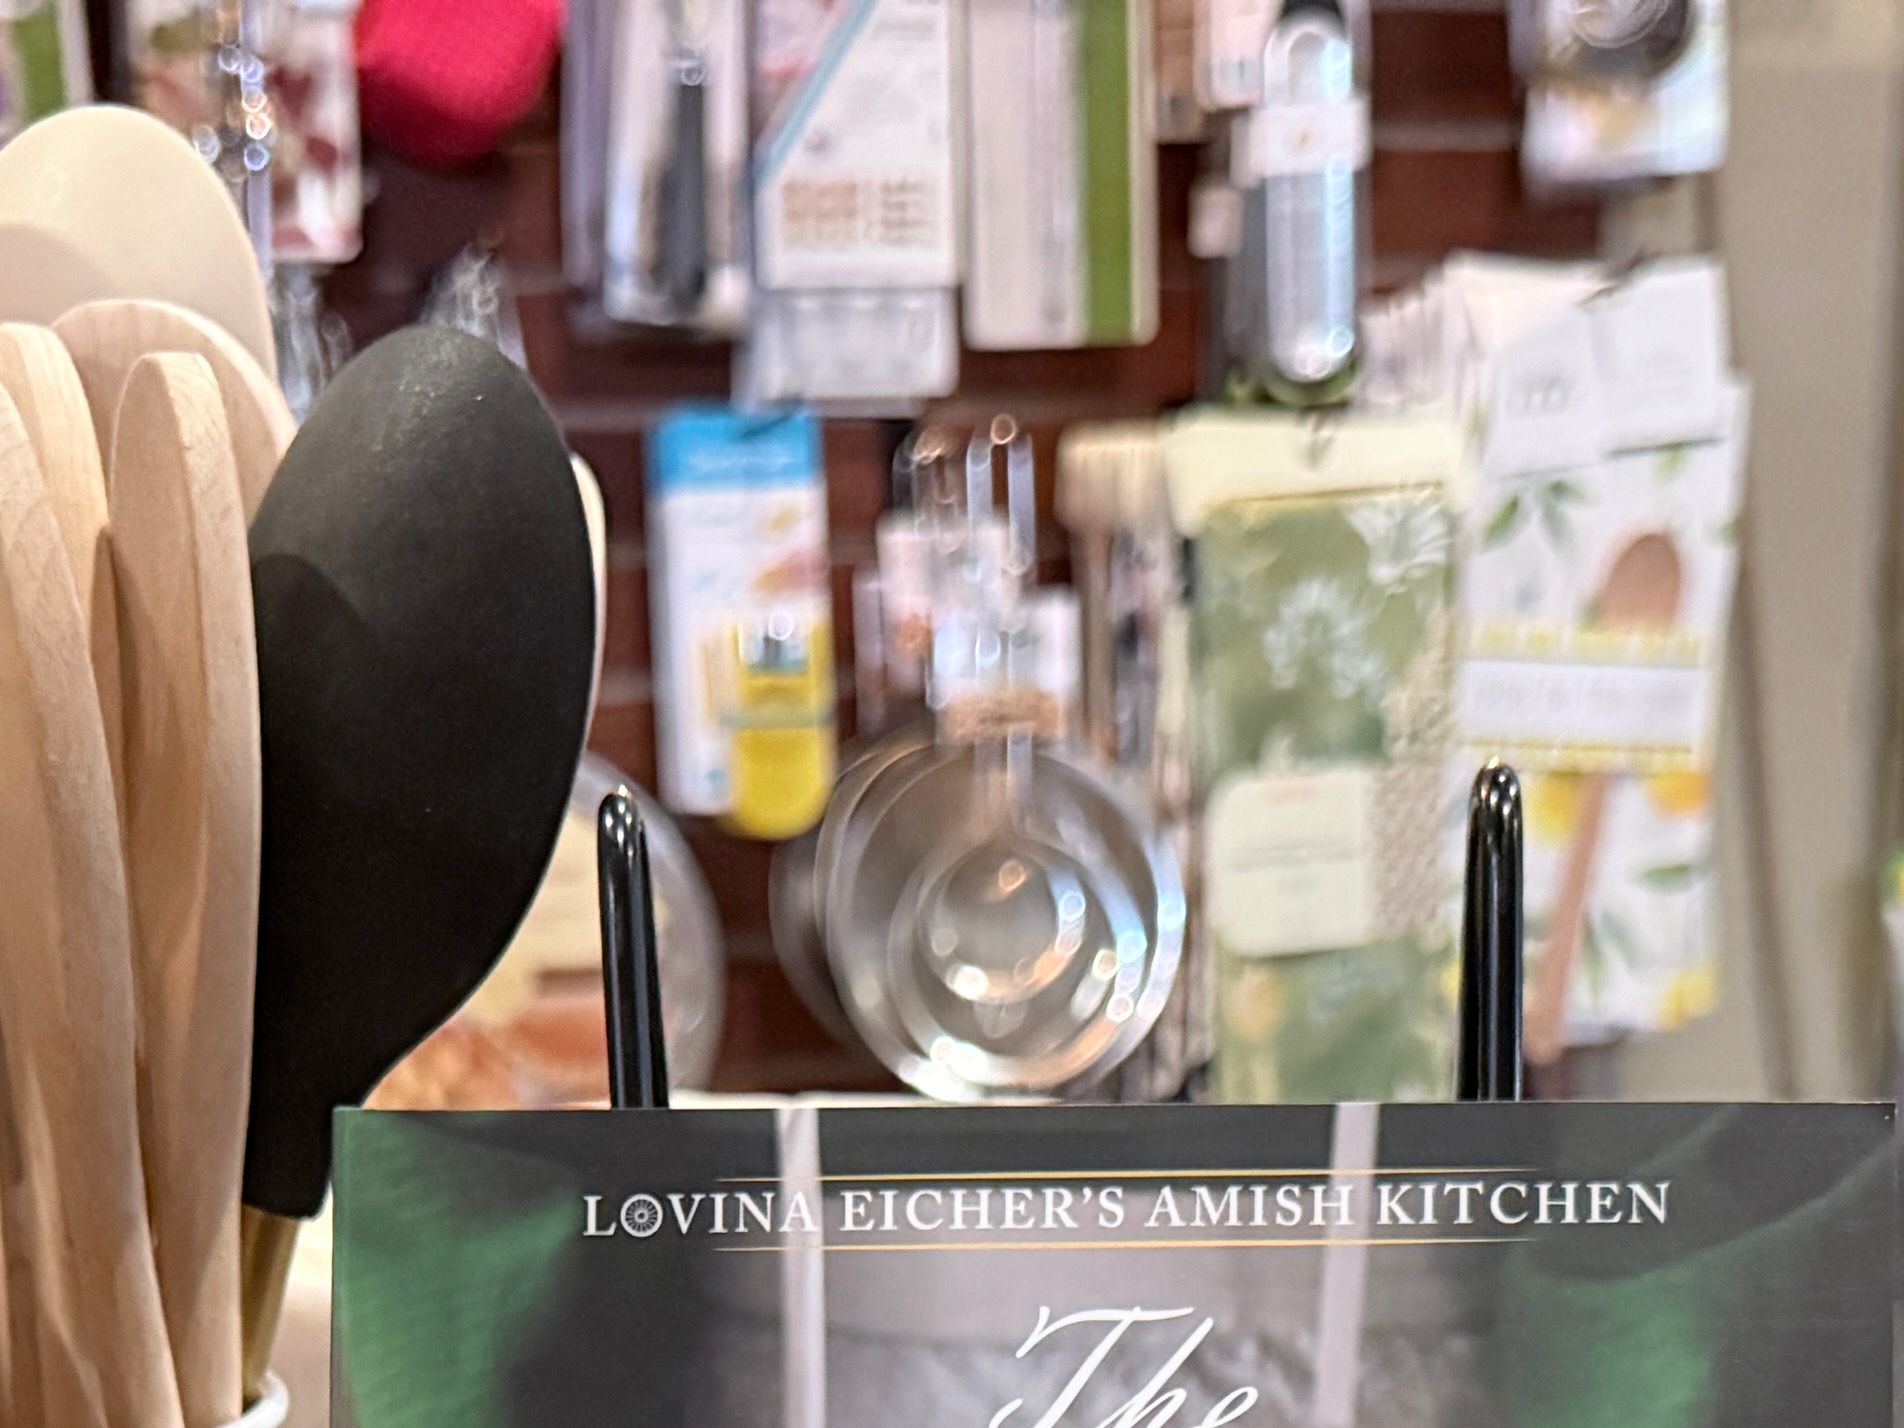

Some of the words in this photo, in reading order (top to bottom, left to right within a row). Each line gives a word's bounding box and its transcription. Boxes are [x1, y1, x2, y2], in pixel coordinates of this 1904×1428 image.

[582, 1192, 817, 1238] LOVINA
[840, 1186, 1124, 1232] EICHER'S
[1144, 1183, 1353, 1228] AMISH
[1376, 1180, 1671, 1226] KITCHEN
